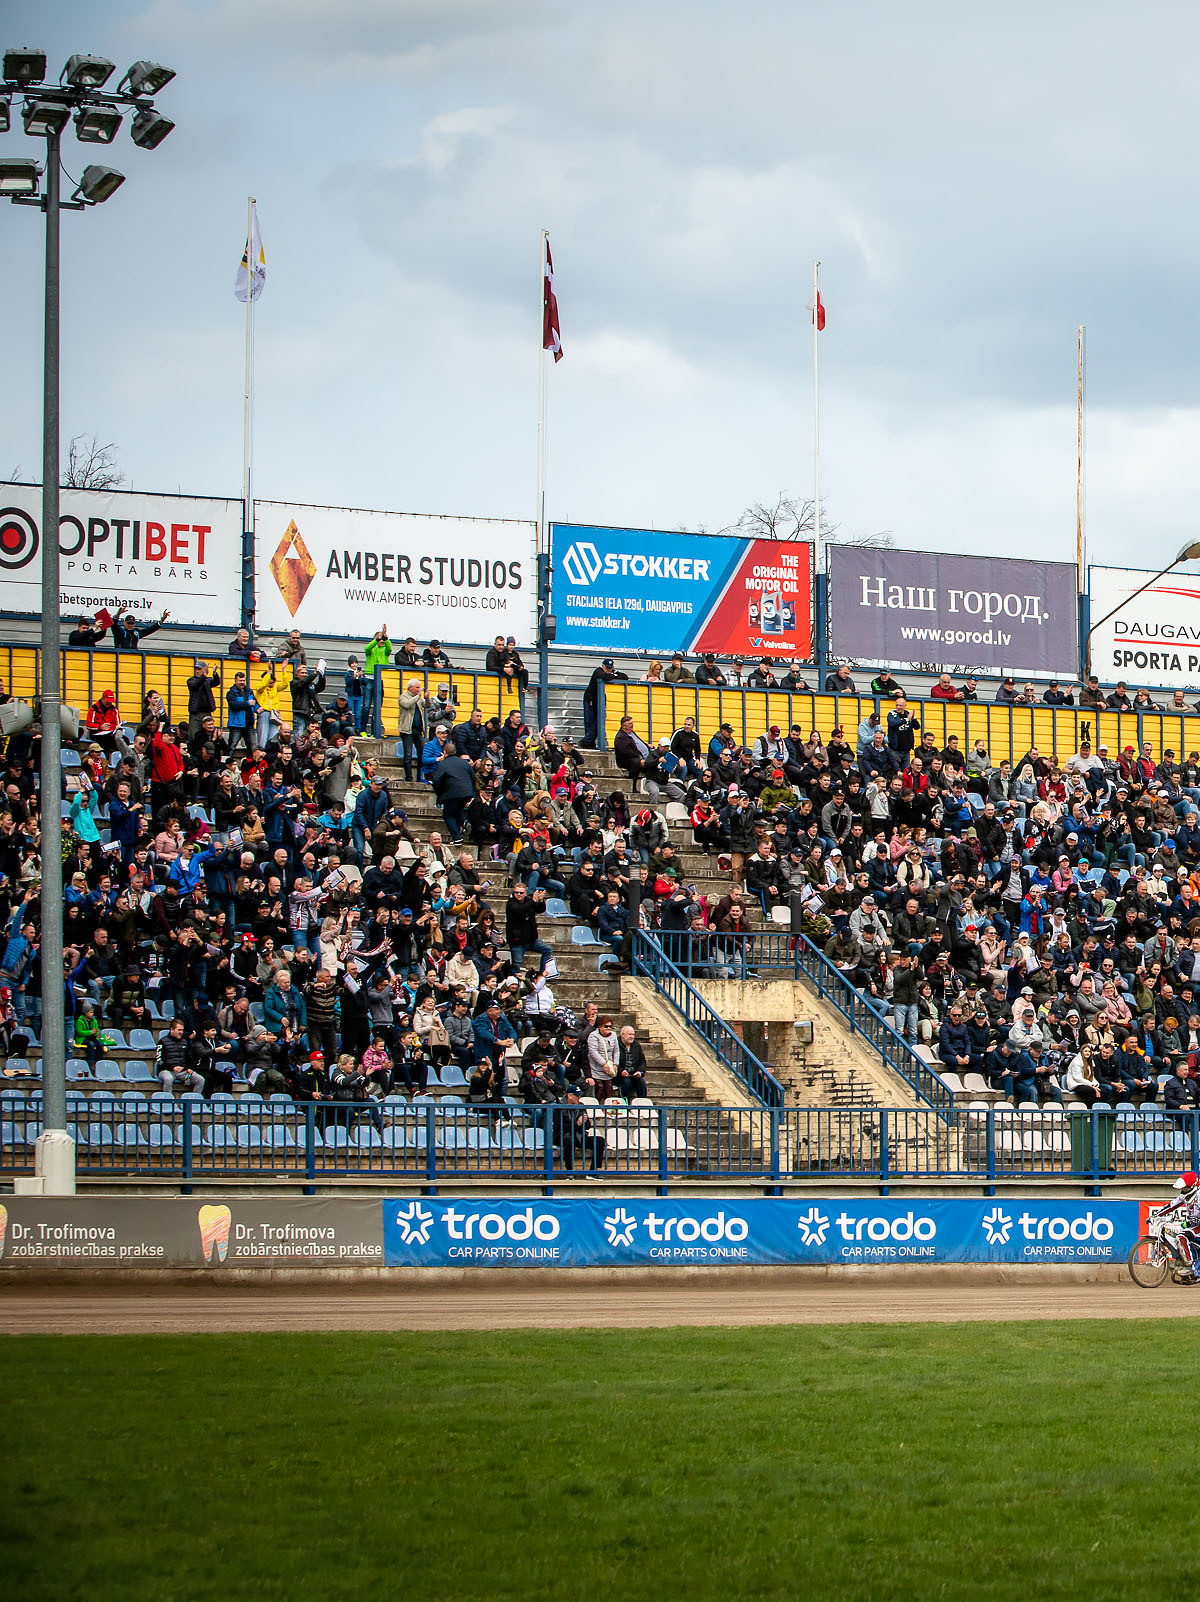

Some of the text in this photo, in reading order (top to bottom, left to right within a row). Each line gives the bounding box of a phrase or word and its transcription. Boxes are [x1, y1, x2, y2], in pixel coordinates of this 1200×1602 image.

[59, 515, 212, 565] OPTIBET
[68, 561, 208, 580] PORTA BĀRS
[326, 549, 522, 590] AMBER STUDIOS
[781, 554, 799, 568] THE
[752, 565, 799, 580] ORIGINAL
[745, 577, 799, 593] MOTOR OIL
[344, 588, 507, 610] WWW.AMBER-STUDIOS.COM
[566, 594, 693, 614] STACIJAS IELA 129d, DAUGAVPILS
[859, 575, 1050, 625] Наш город.
[566, 616, 631, 629] www.stokker.lv
[901, 626, 1012, 646] www.gorod.lv
[1113, 650, 1182, 671] SPORTA
[1081, 721, 1091, 741] K
[11, 1223, 116, 1240] Dr. Trofimova
[235, 1223, 336, 1240] Dr. Trofimova
[440, 1207, 561, 1241] trodo
[643, 1211, 749, 1242] trodo
[835, 1211, 937, 1241] trodo
[1018, 1211, 1114, 1241] trodo
[11, 1241, 165, 1259] zobārstniecības prakse
[235, 1241, 382, 1258] zobārstniecības prakse
[448, 1246, 560, 1259] CAR PARTS ONLINE
[650, 1247, 748, 1258] CAR PARTS ONLINE
[841, 1246, 935, 1257] CAR PARTS ONLINE
[1023, 1246, 1112, 1256] CAR PARTS ONLINE
